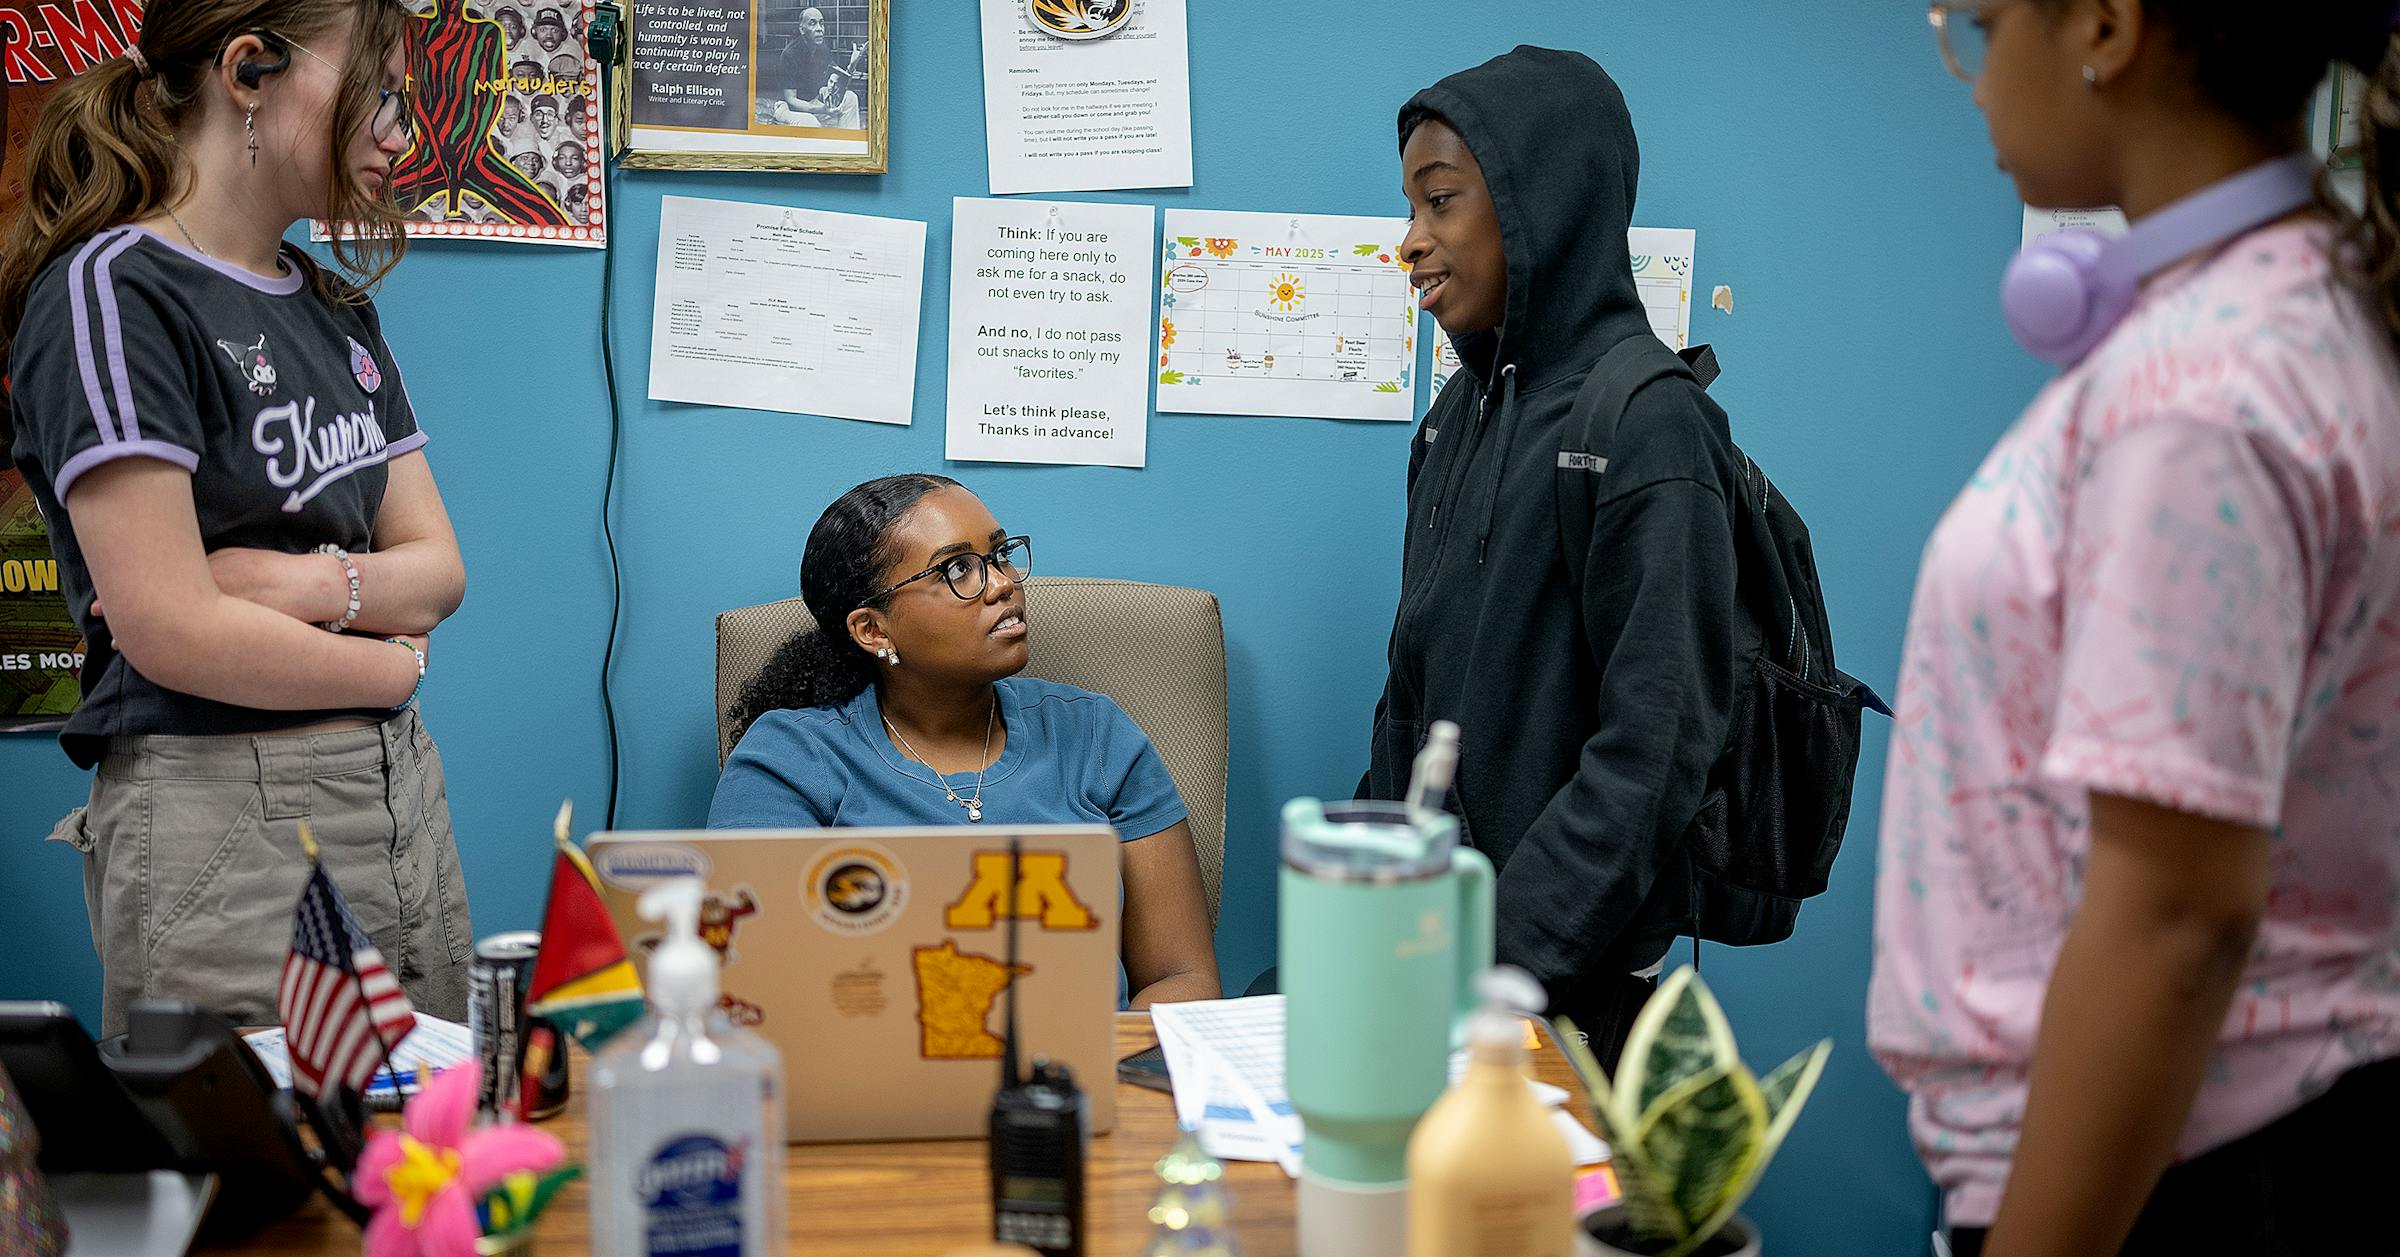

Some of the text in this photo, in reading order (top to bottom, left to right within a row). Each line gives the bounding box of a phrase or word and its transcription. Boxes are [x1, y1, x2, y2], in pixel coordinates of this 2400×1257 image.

[657, 5, 665, 15] is
[668, 7, 679, 15] to
[682, 7, 694, 16] be
[697, 7, 723, 19] lived,
[727, 10, 745, 19] not
[649, 20, 727, 32] controlled, and
[638, 32, 738, 49] humanity is won by
[635, 47, 739, 62] continuing to play in
[653, 60, 665, 72] of
[666, 62, 702, 72] certain
[652, 84, 722, 96] Ralph Ellison
[683, 97, 707, 106] Literary
[709, 98, 725, 106] Critic
[998, 227, 1108, 244] Think: If you are
[987, 248, 1116, 265] coming here only to
[1265, 247, 1324, 258] MAY 2025
[977, 267, 1126, 284] ask me for a snack, do
[988, 287, 1113, 303] not even try to ask.
[977, 325, 1121, 343] And no, I do not pass
[978, 346, 1120, 364] out snacks to only my
[1022, 406, 1056, 417] think
[1061, 407, 1110, 421] please,
[978, 423, 1114, 439] Thanks in advance!
[0, 559, 58, 592] OW
[0, 653, 31, 670] ES
